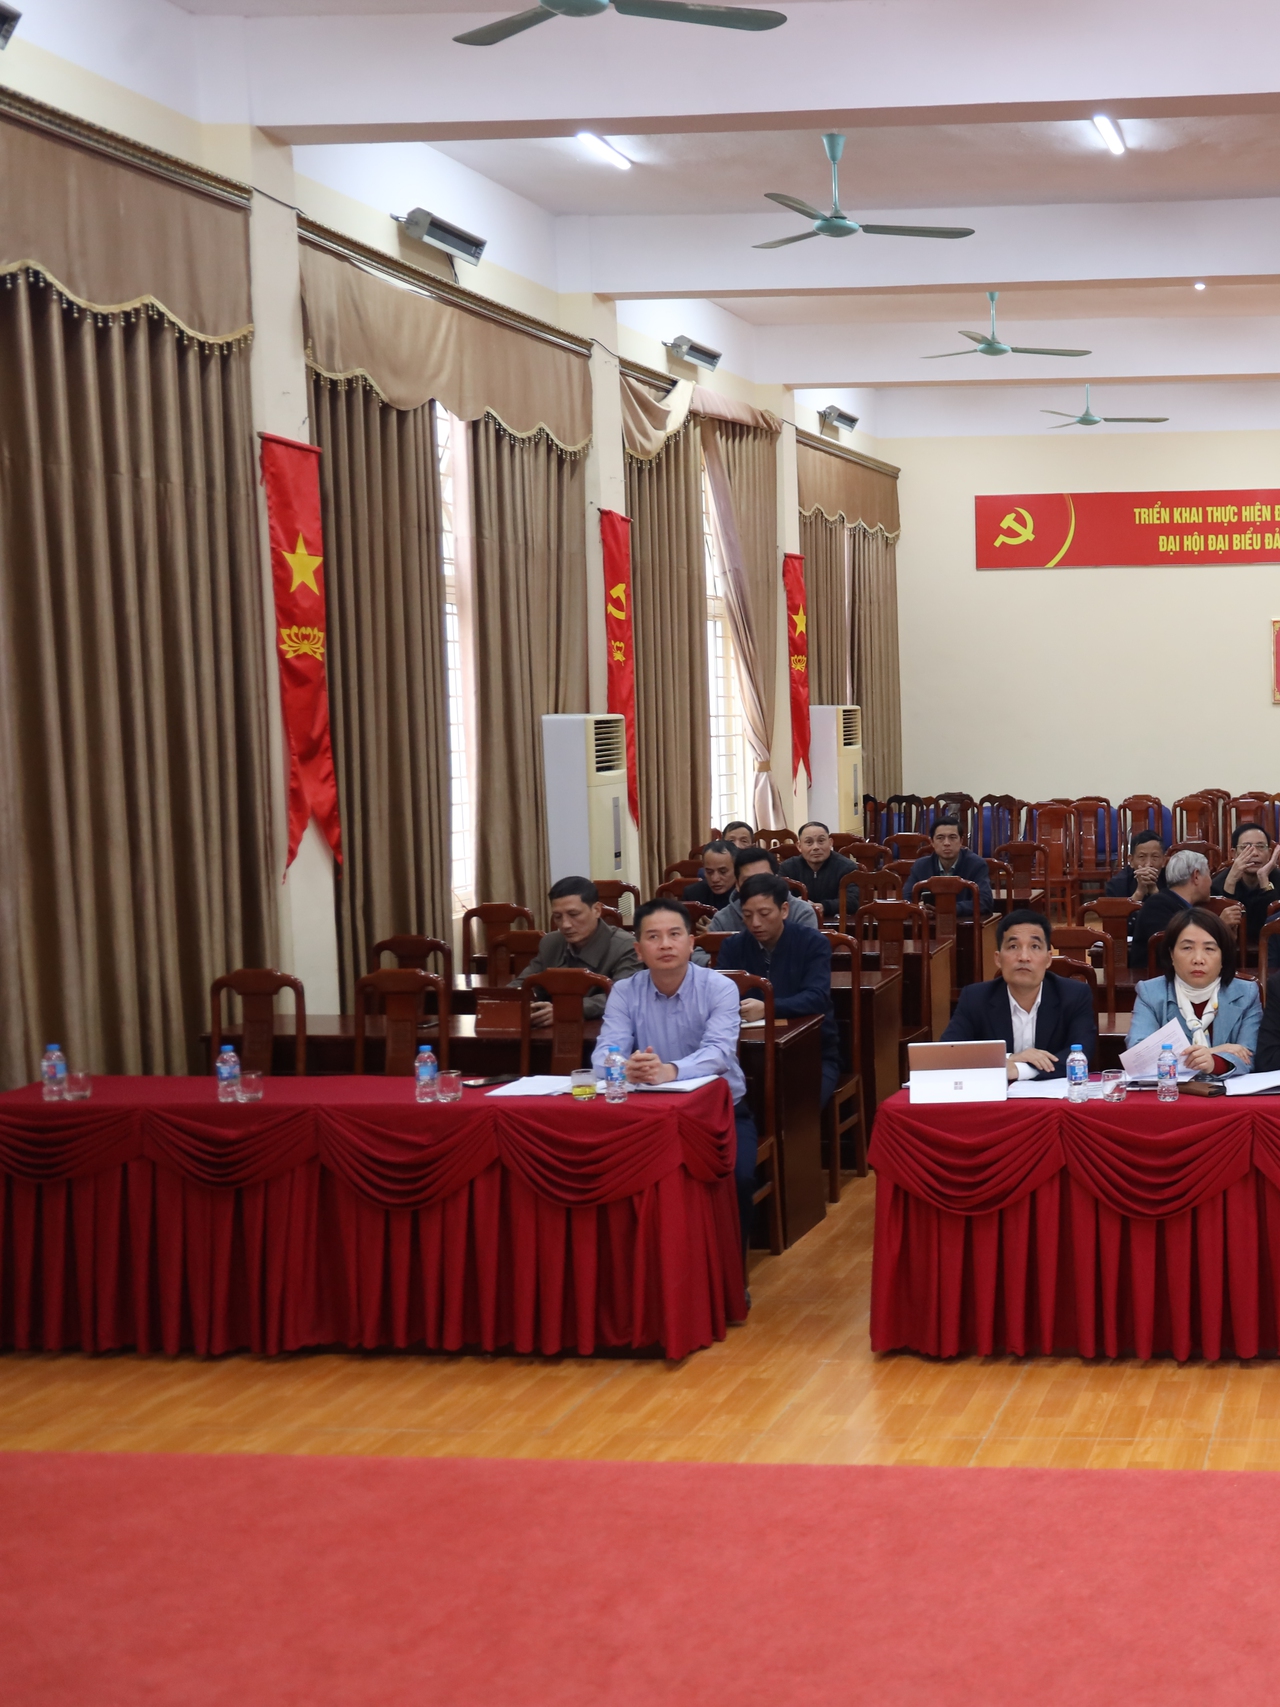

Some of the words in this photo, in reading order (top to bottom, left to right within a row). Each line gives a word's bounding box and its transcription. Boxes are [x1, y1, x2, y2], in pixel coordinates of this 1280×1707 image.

[1134, 501, 1170, 524] TRIỂN
[1173, 506, 1203, 524] KHAI
[1206, 505, 1239, 526] THỰC
[1241, 502, 1272, 525] HIỆN
[1158, 535, 1180, 555] ĐẠI
[1183, 532, 1205, 555] HỘI
[1207, 534, 1229, 554] ĐẠI
[1232, 527, 1261, 550] BIỂU
